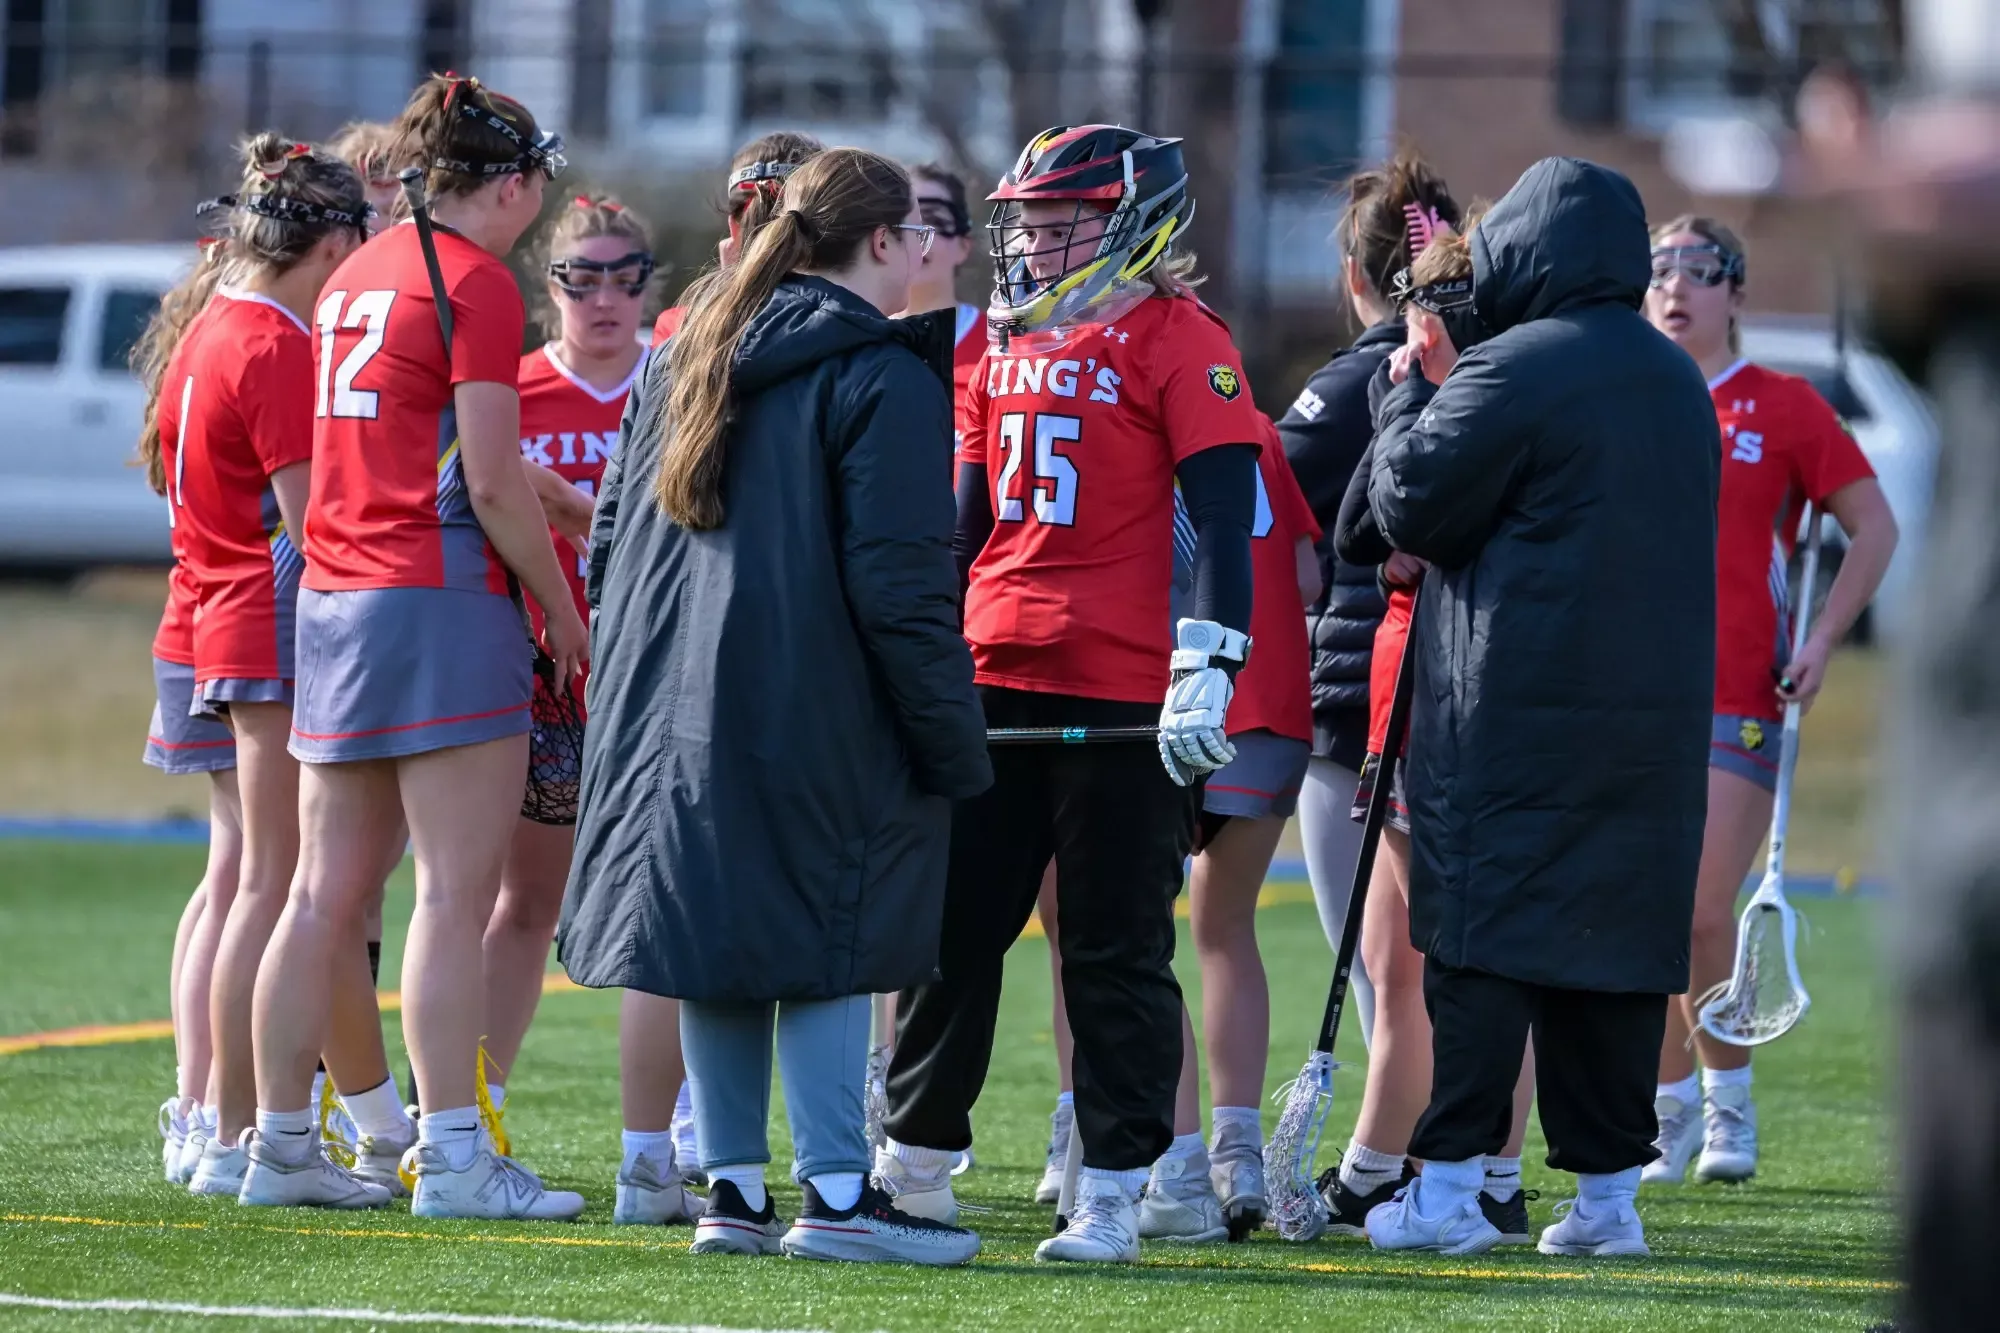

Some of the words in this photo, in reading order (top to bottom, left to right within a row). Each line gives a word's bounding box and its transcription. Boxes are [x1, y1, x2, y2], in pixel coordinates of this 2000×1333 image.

[483, 160, 520, 173] STX
[316, 289, 399, 420] 12
[997, 411, 1083, 528] 25
